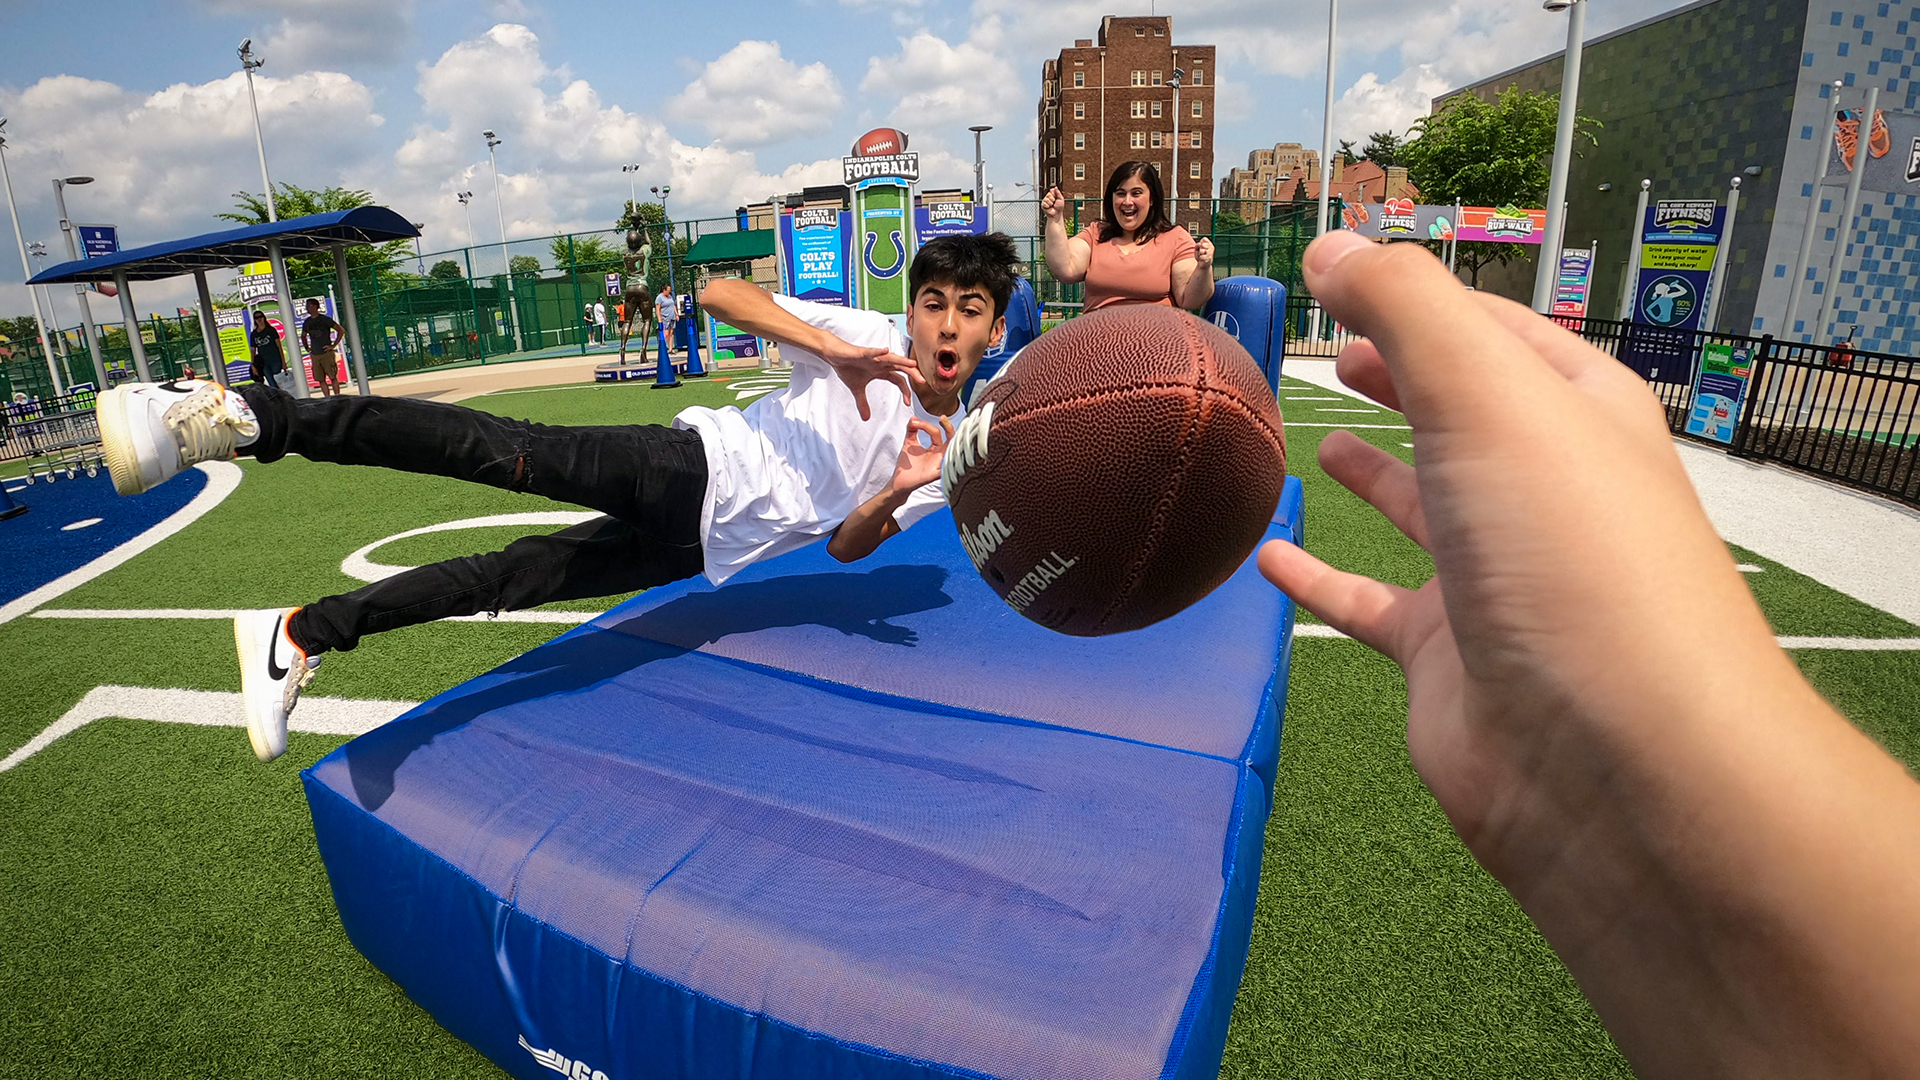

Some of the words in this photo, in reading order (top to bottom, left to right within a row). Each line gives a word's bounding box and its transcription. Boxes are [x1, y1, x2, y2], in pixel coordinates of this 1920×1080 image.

[845, 155, 894, 163] INDIANAPOLIS
[845, 160, 917, 181] FOOTBALL
[802, 209, 829, 217] COLTS
[931, 210, 972, 221] FOOTBALL
[1657, 208, 1711, 222] FITNESS
[795, 215, 836, 228] FOOTBALL
[1380, 218, 1415, 229] FITNESS
[1487, 221, 1532, 232] RUN-WALK
[800, 251, 836, 262] COLTS
[803, 261, 833, 272] PLAY
[798, 271, 839, 279] FOOTBALL!
[240, 283, 277, 300] TENN
[220, 336, 243, 344] TENNIS
